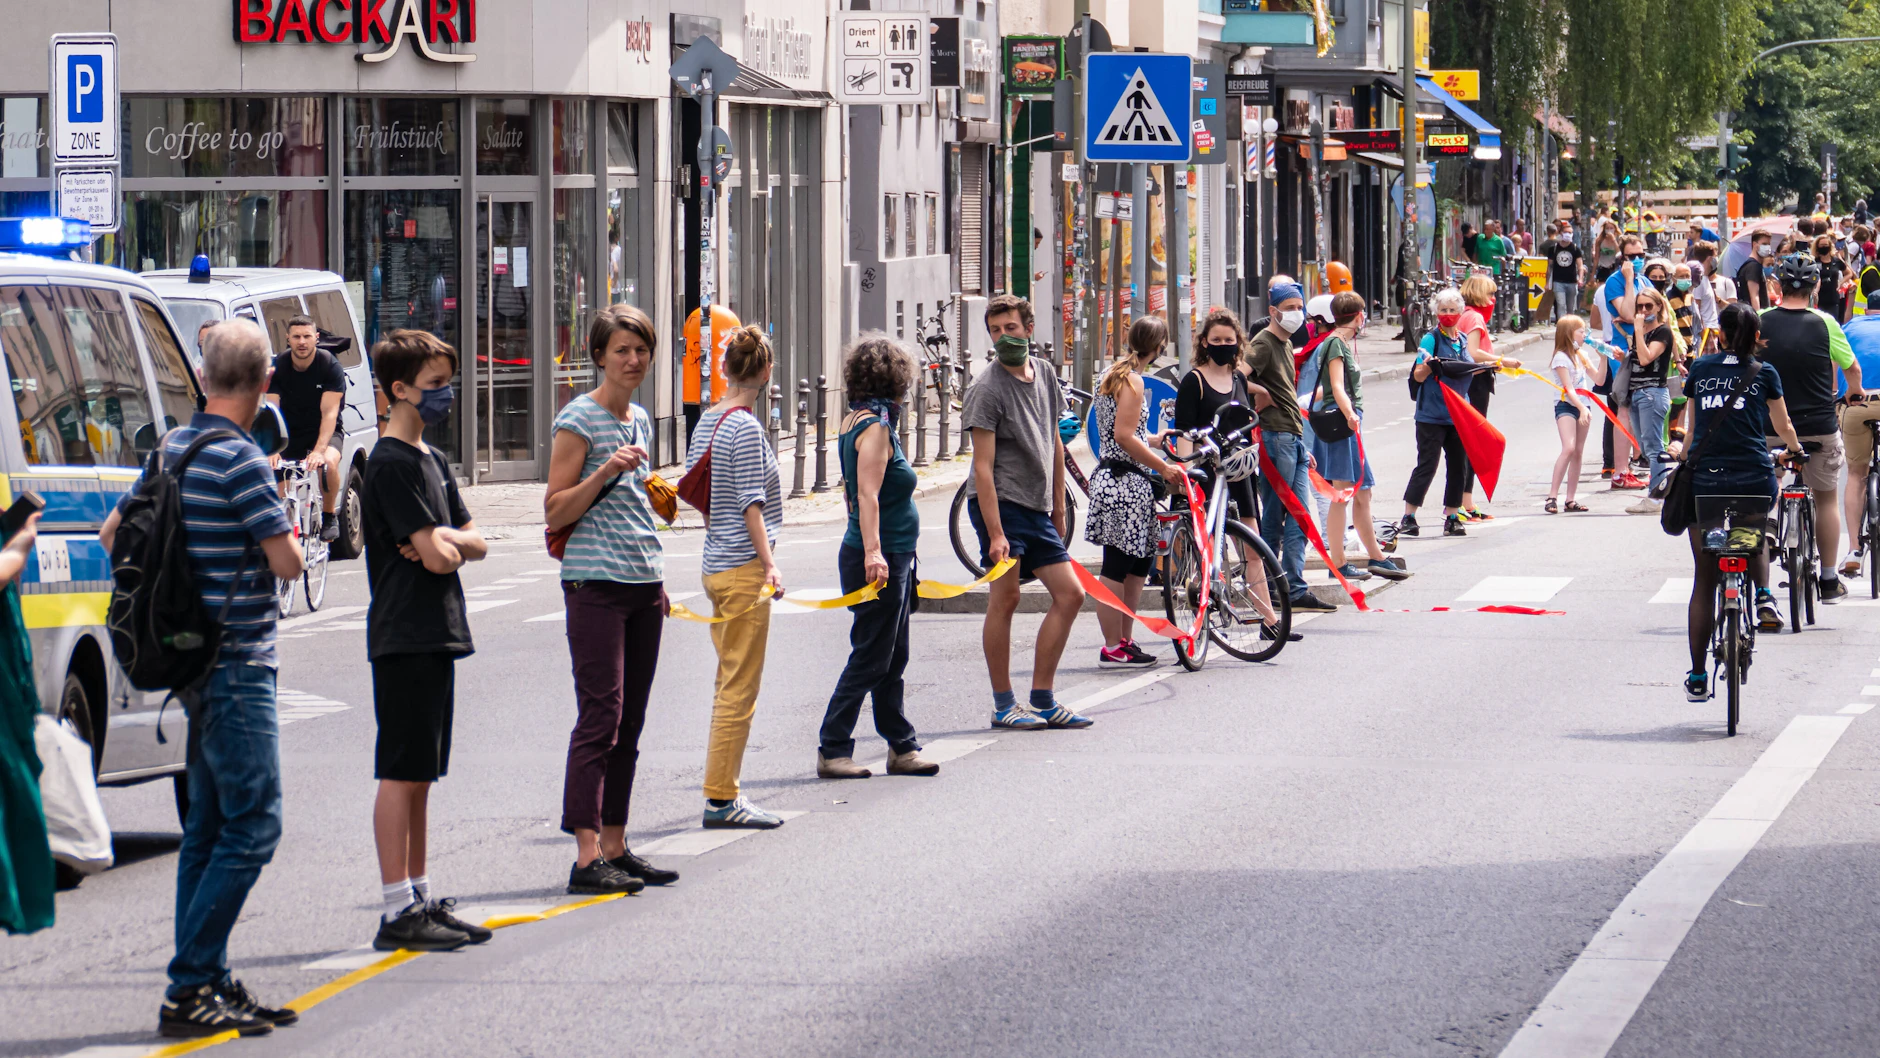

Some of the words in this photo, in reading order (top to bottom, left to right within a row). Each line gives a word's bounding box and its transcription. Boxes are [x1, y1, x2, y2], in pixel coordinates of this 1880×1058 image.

[848, 28, 876, 36] Orient
[936, 49, 957, 57] More
[75, 64, 95, 114] P
[1228, 79, 1270, 90] REISFREUDE
[71, 132, 101, 149] ZONE
[145, 122, 222, 160] Coffee
[229, 128, 253, 150] to
[256, 131, 284, 160] go
[354, 120, 448, 155] Frühstück
[483, 121, 523, 151] Salate
[1432, 136, 1452, 145] Post
[1694, 375, 1760, 396] TSCHÜS
[1701, 394, 1746, 411] HAS
